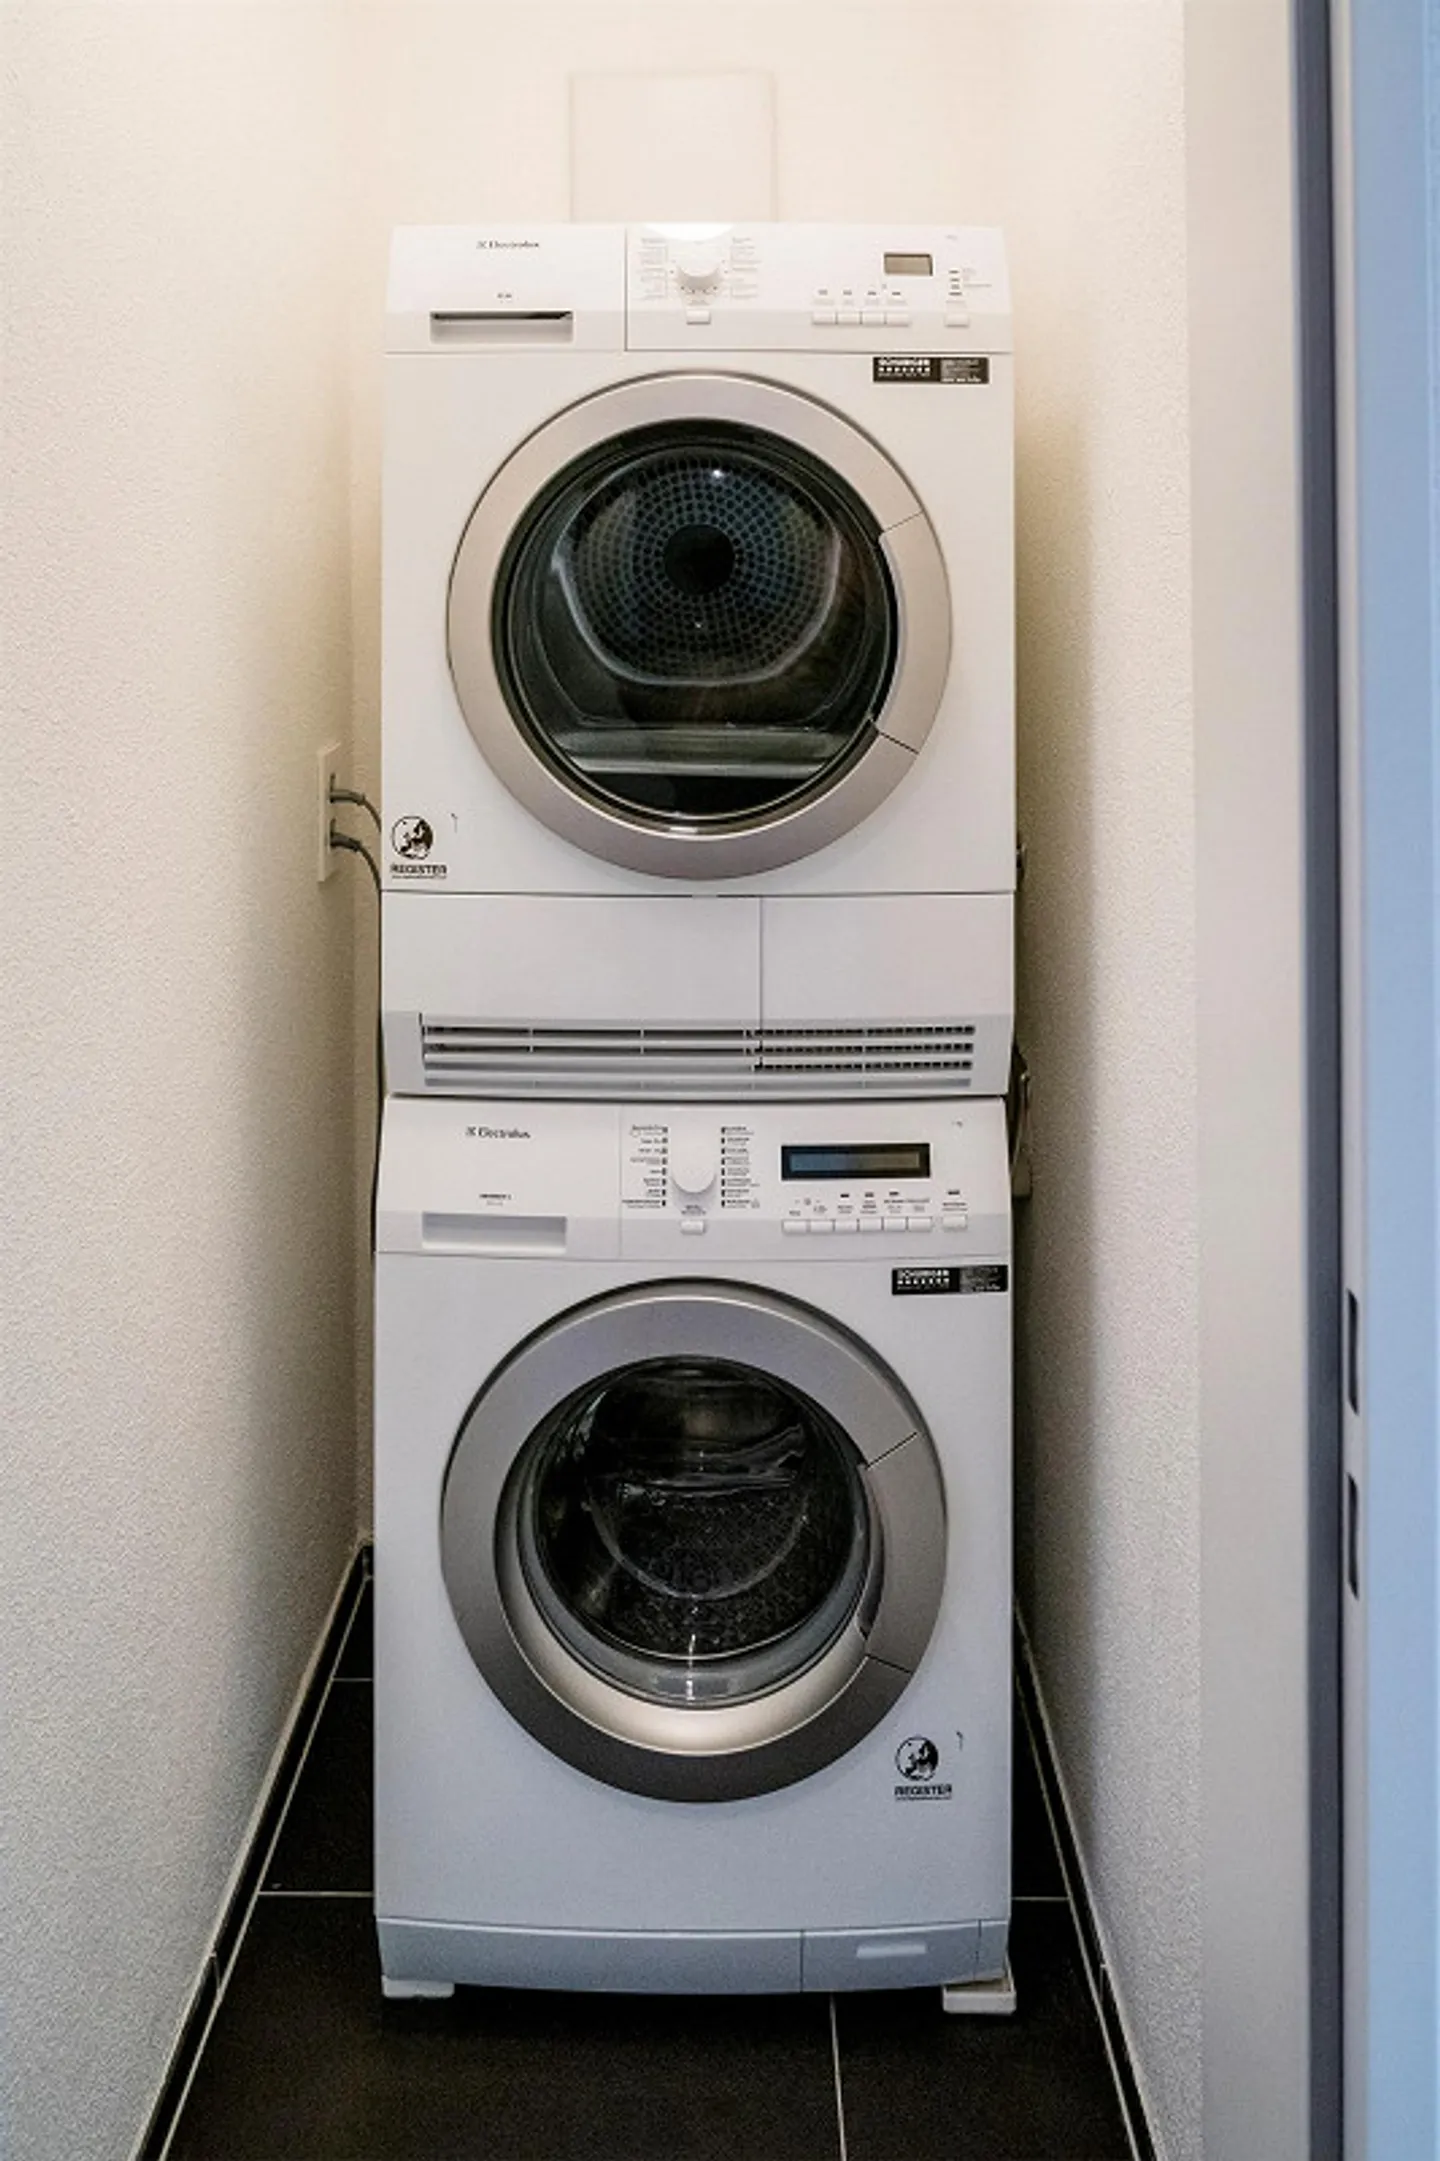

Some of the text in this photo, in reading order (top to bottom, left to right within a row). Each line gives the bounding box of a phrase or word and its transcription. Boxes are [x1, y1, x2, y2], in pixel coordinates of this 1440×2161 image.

[391, 865, 447, 874] REGISTER
[479, 1126, 531, 1139] Electrolux
[895, 1784, 952, 1795] REGISTER
